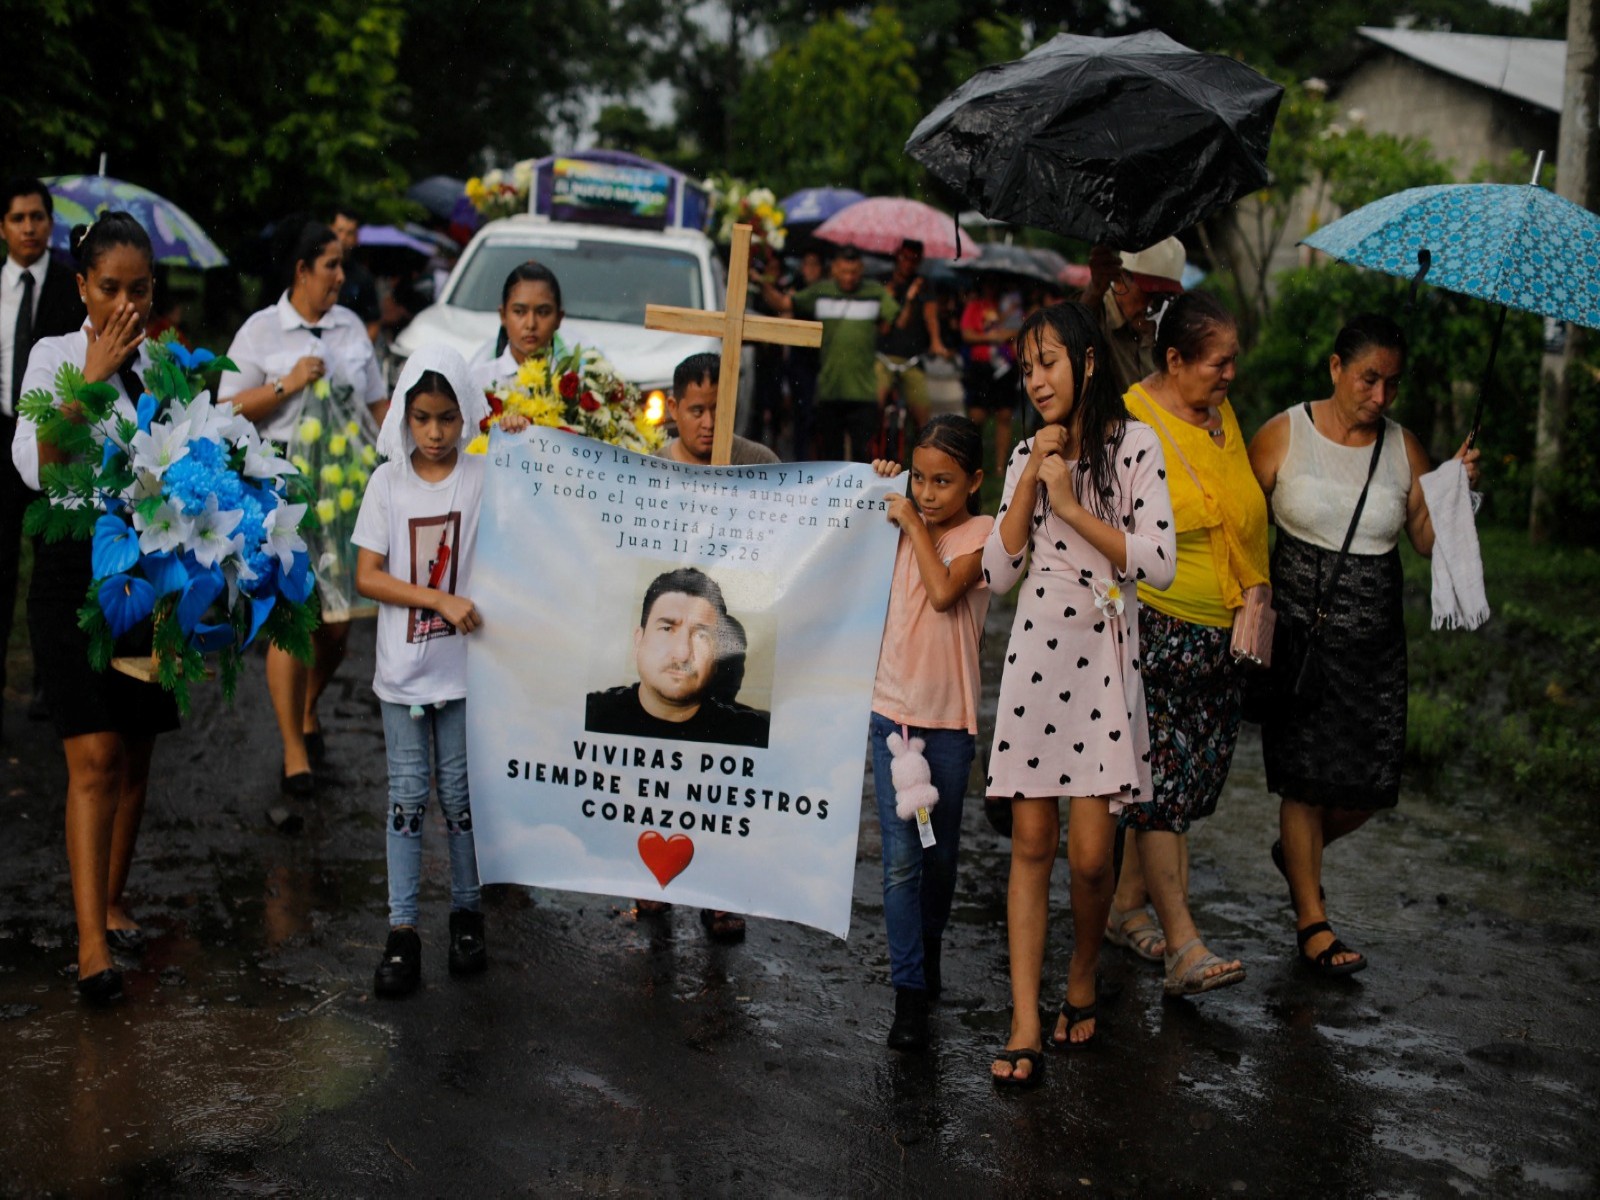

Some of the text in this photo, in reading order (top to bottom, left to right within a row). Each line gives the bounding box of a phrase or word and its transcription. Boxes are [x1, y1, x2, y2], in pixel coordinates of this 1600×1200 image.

[495, 453, 511, 468] el
[521, 460, 555, 474] que
[565, 467, 606, 481] cree
[617, 473, 637, 485] en
[681, 480, 739, 498] vivirá
[750, 489, 819, 504] aunque
[828, 495, 886, 511] muera
[572, 446, 603, 464] soy
[613, 450, 630, 465] la
[779, 471, 788, 486] y
[798, 470, 814, 485] la
[826, 474, 864, 489] vida
[534, 482, 851, 529] y todo el que vive y cree en mí
[601, 511, 624, 524] no
[634, 515, 699, 533] morirá
[616, 531, 662, 549] Juan
[573, 740, 754, 777] VIVIRAS POR
[506, 759, 829, 820] SIEMPRE EN NUESTROS
[581, 799, 751, 837] CORAZONES
